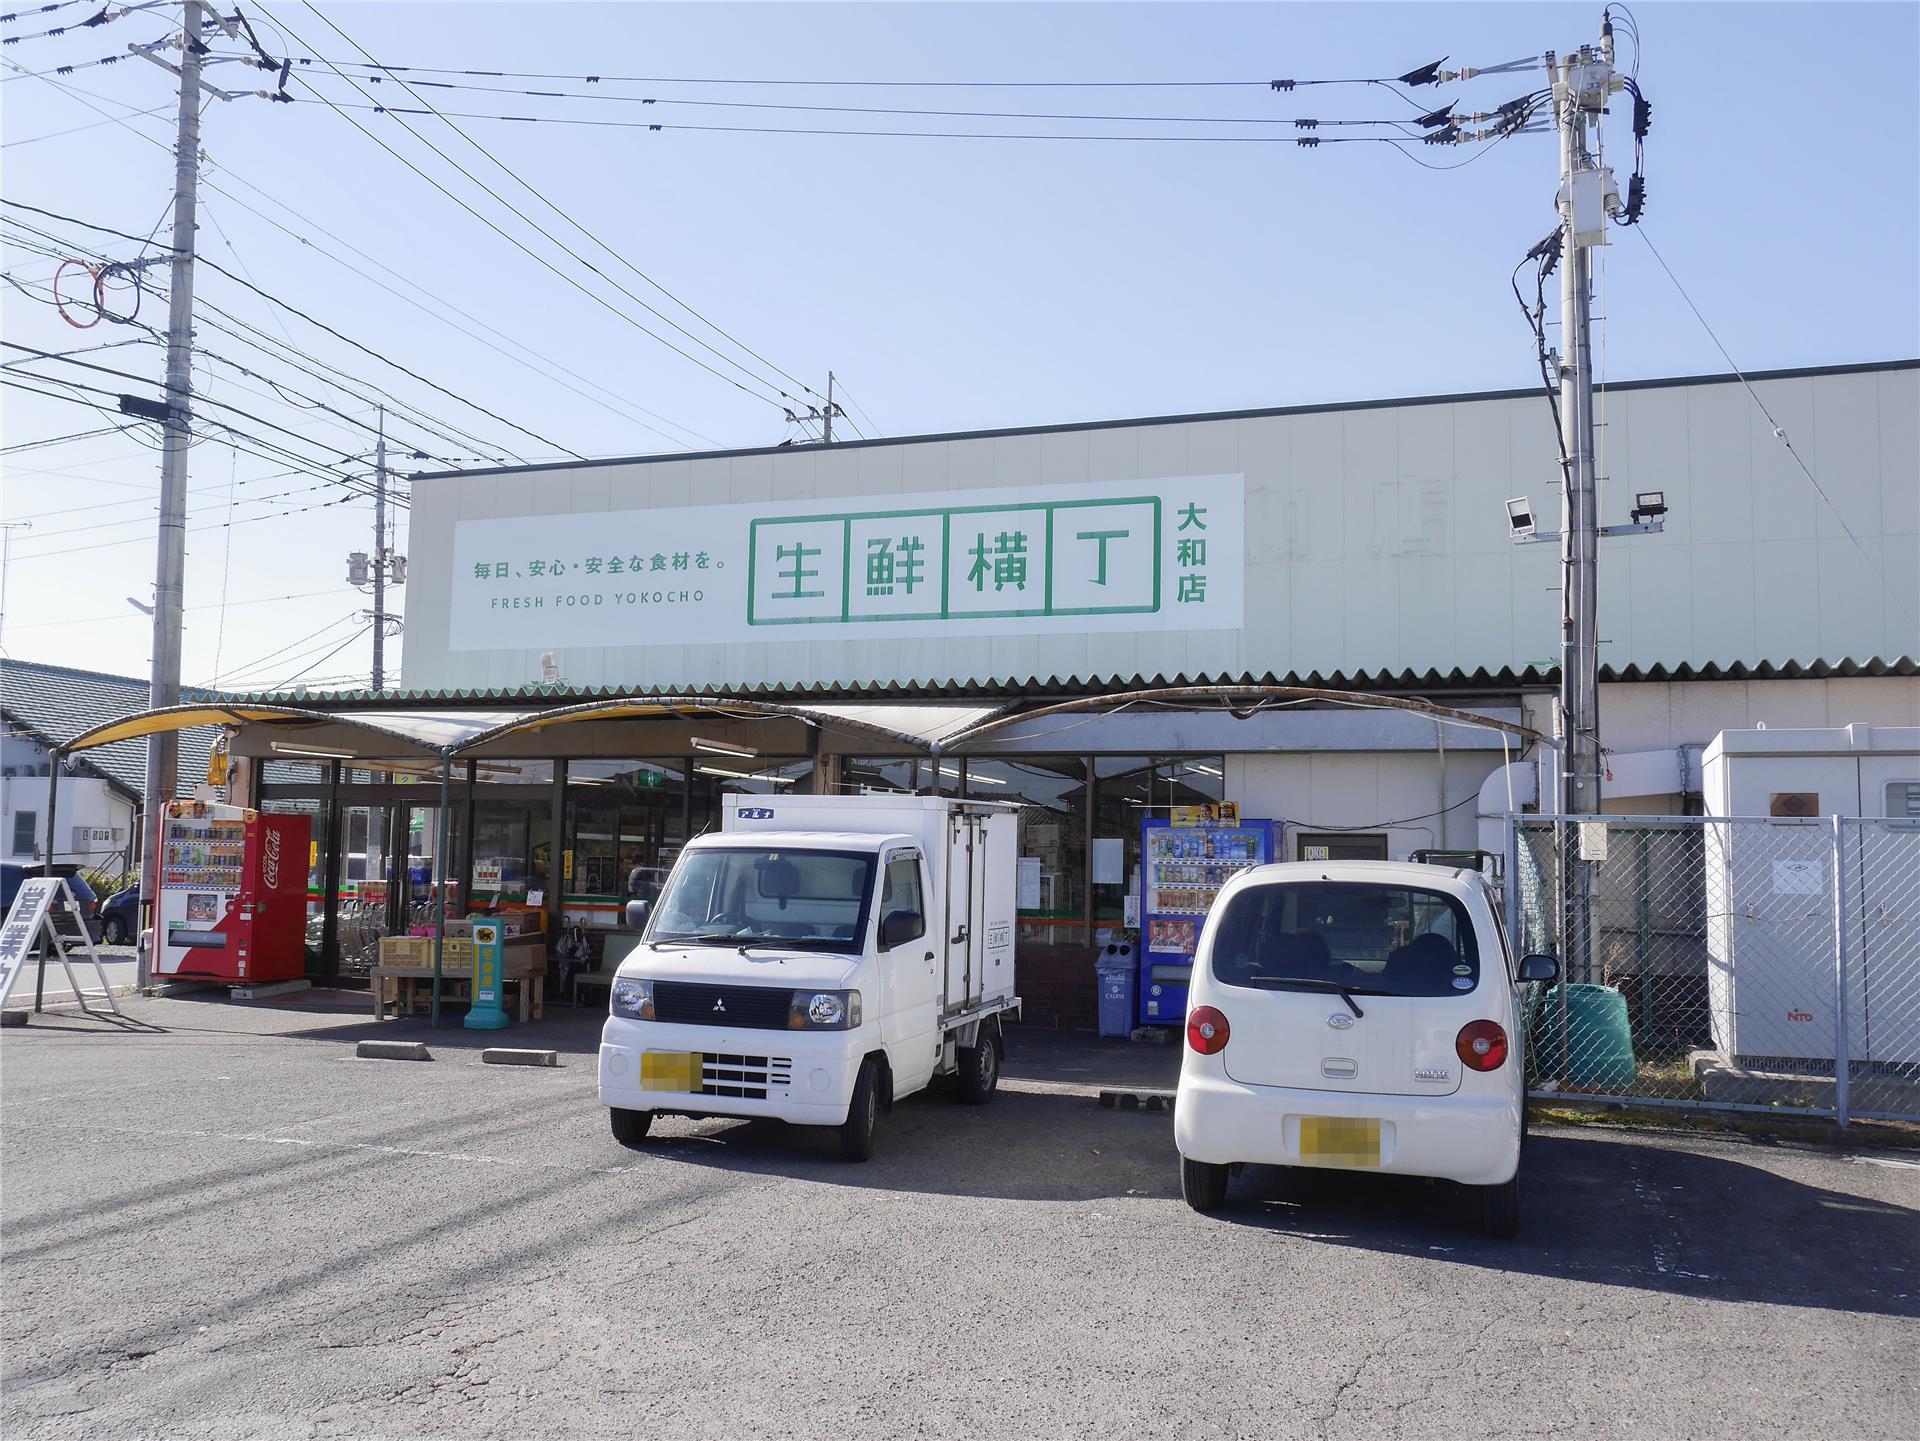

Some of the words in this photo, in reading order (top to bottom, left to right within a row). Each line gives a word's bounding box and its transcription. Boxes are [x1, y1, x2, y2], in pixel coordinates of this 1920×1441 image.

[473, 551, 725, 580] 毎日、安心・安全な食材を。
[771, 529, 1130, 599] 生鮮横丁
[1177, 502, 1207, 604] 大和店
[491, 596, 544, 609] FRESH
[555, 594, 603, 607] FOOD
[615, 590, 704, 605] YOKOCHO
[263, 825, 280, 889] Coca-Cola
